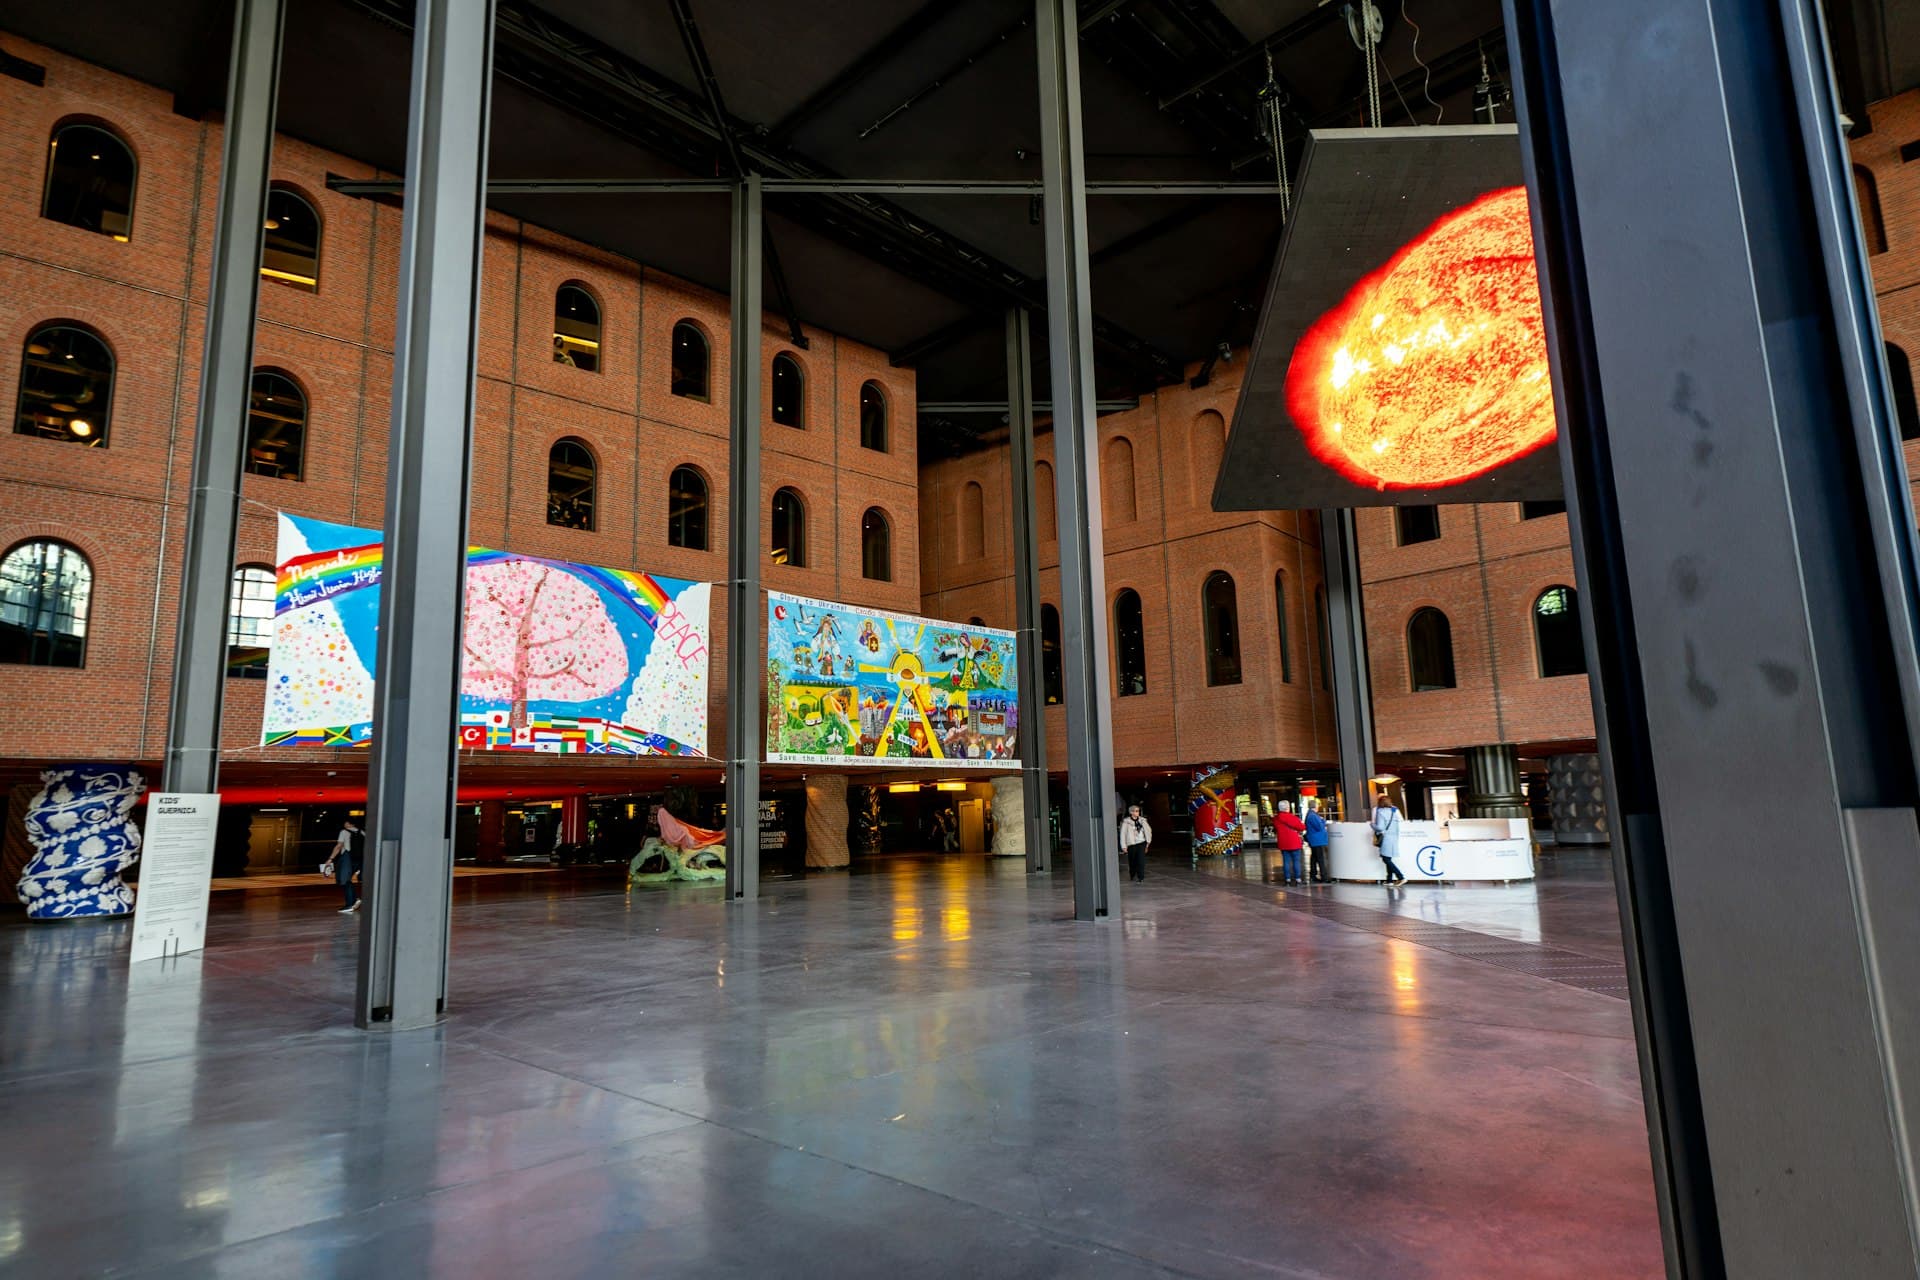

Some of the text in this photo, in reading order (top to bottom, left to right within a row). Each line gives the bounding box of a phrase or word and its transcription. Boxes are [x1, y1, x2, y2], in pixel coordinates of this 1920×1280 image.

[648, 599, 709, 671] PEACE
[779, 753, 796, 761] Save
[802, 754, 815, 762] the
